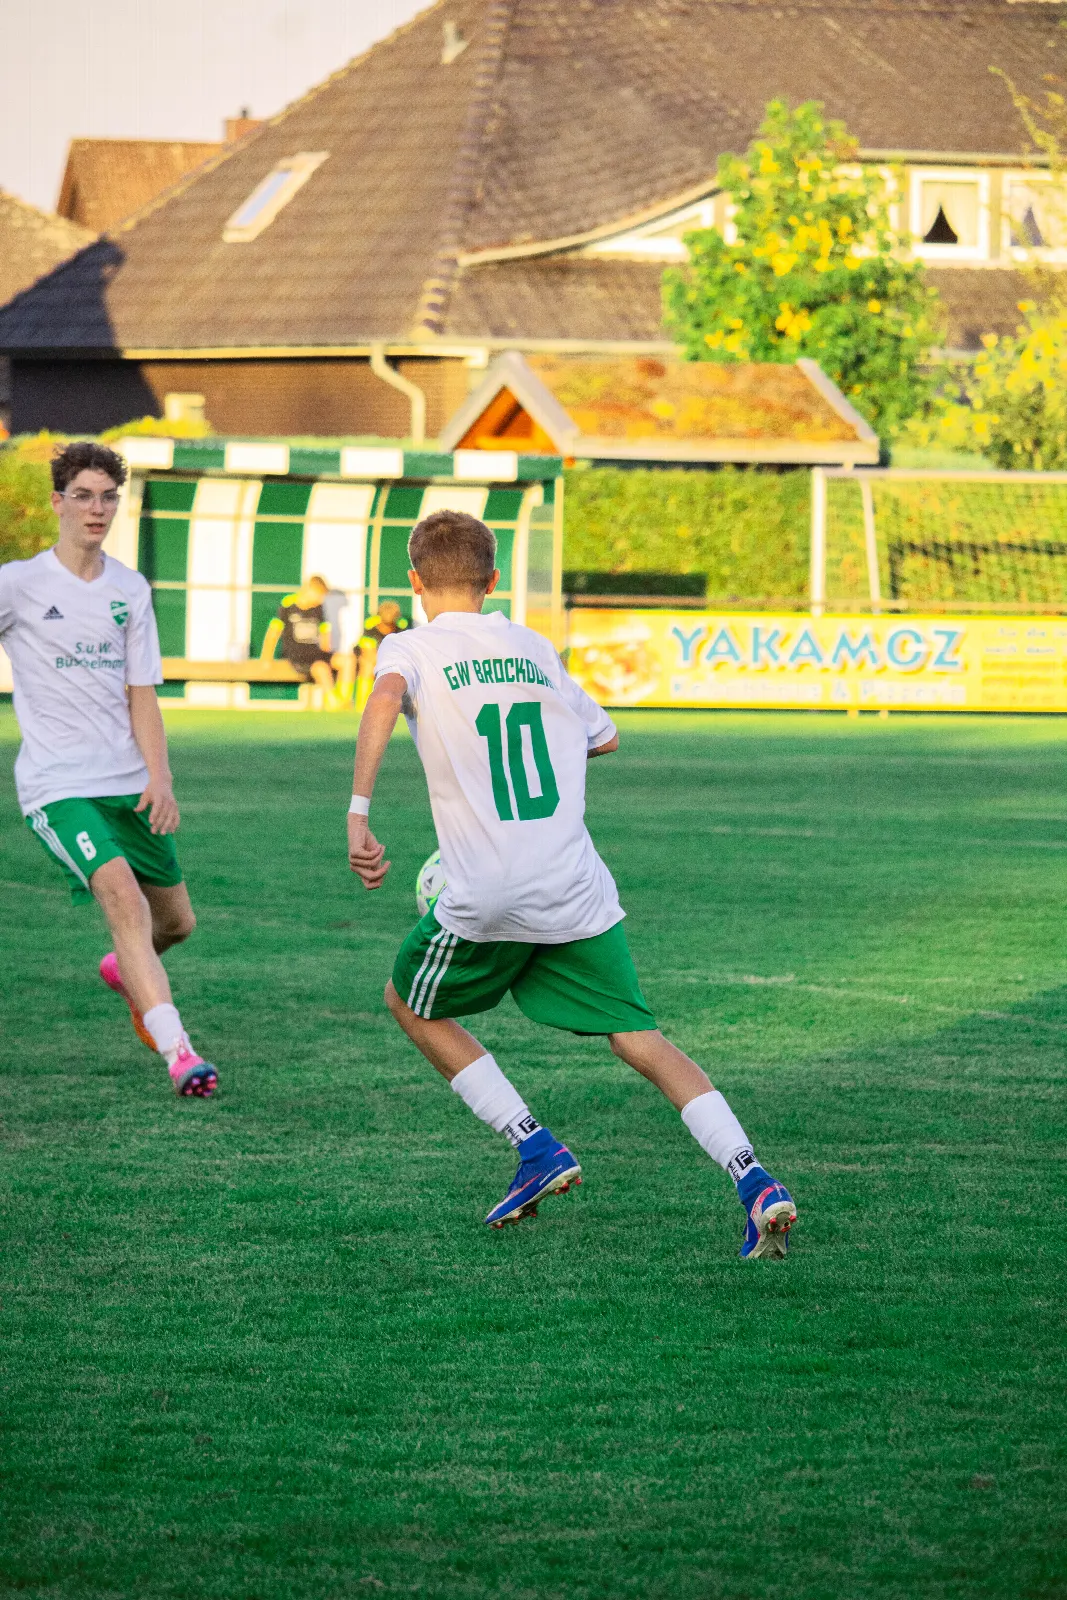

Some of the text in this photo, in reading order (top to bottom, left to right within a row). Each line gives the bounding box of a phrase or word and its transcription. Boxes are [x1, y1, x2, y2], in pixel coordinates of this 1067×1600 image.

[443, 660, 471, 691] GW
[475, 702, 560, 821] 10
[76, 831, 97, 861] 6
